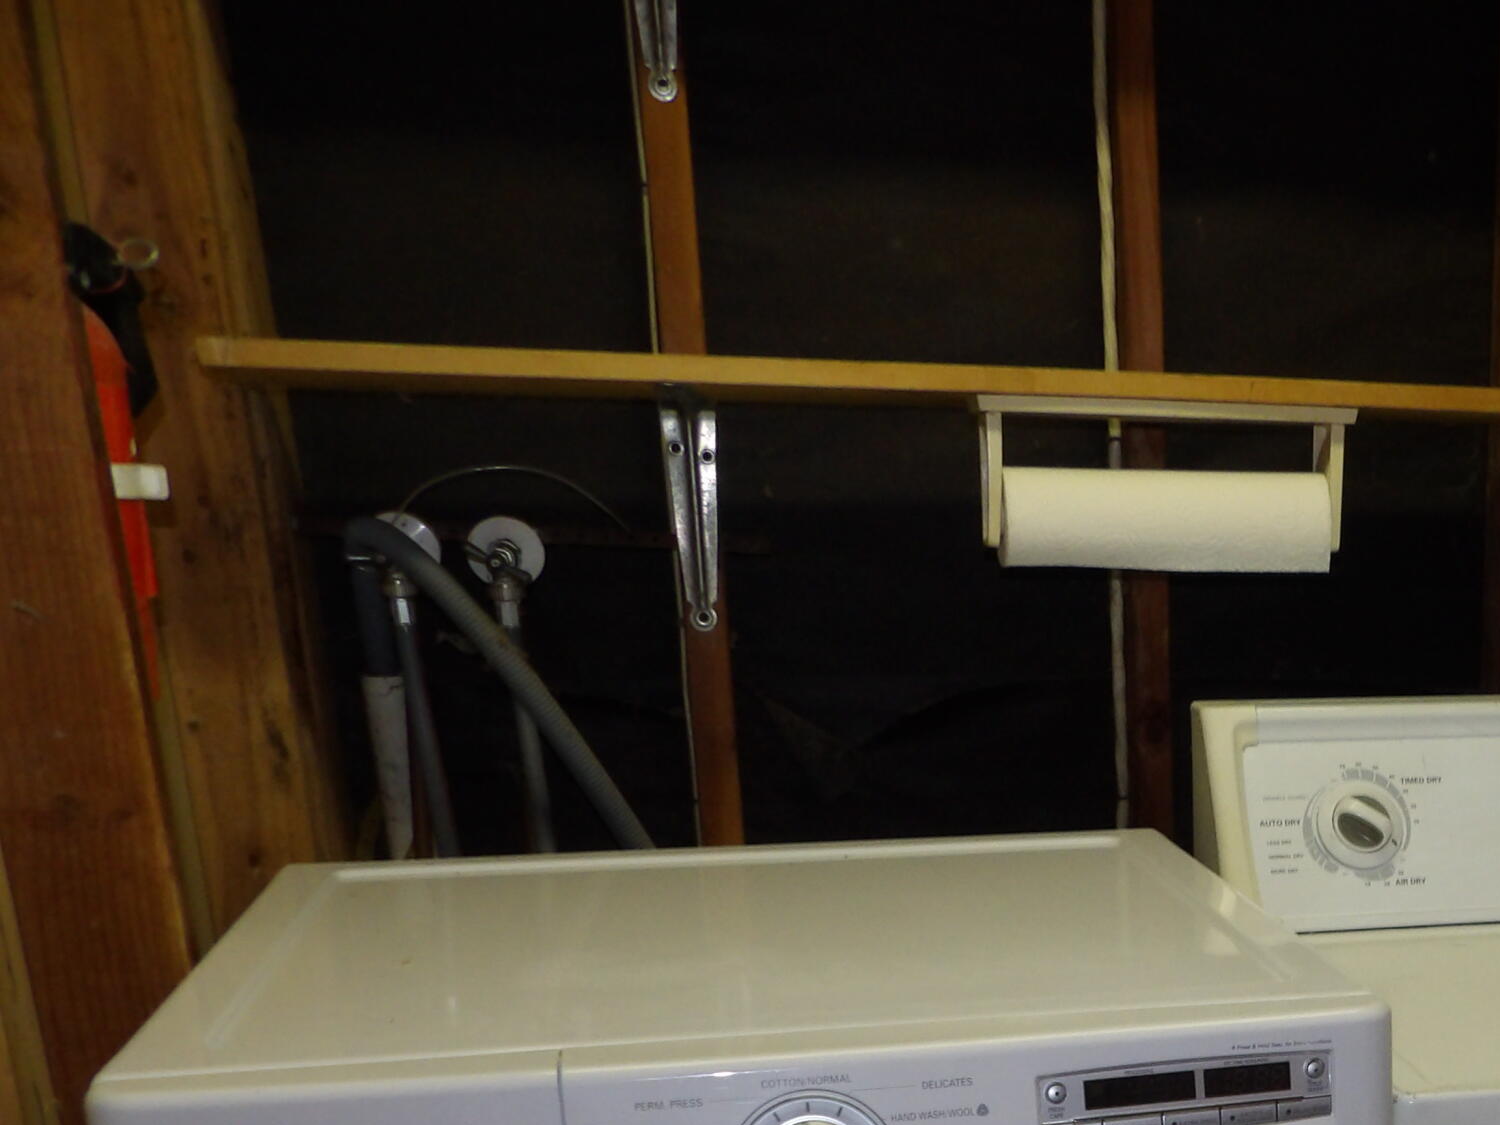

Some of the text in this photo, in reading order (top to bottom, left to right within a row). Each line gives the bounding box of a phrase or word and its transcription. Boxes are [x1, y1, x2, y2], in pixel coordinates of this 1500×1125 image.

[1401, 776, 1442, 785] TIMED DRY
[1260, 818, 1301, 828] AUTO DRY
[1396, 878, 1408, 887] AIR
[1410, 877, 1426, 886] DRY
[921, 1077, 973, 1090] DELICATES
[669, 1098, 704, 1109] PRESS
[890, 1111, 917, 1122] HAND
